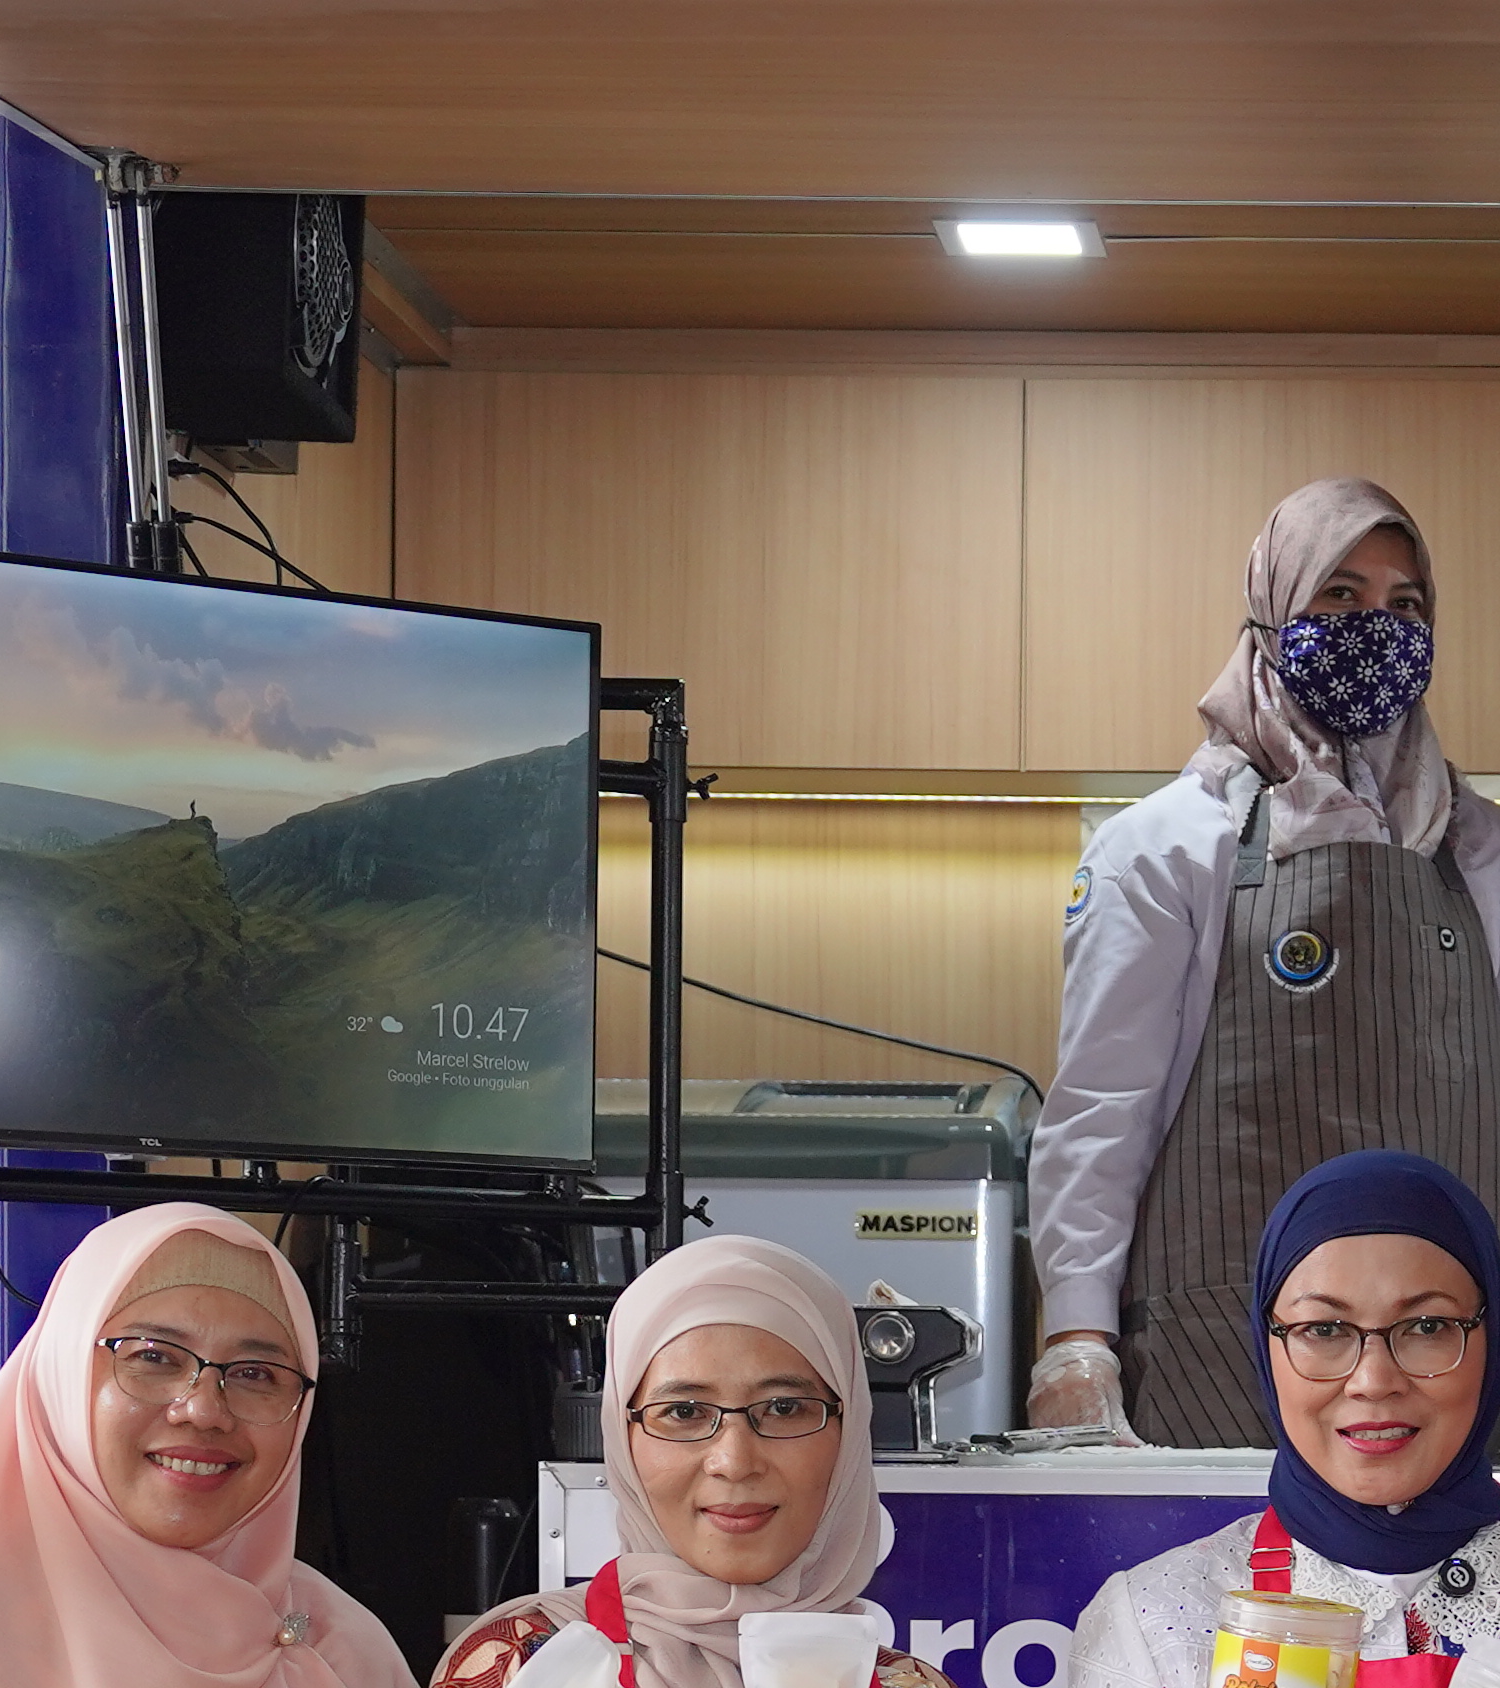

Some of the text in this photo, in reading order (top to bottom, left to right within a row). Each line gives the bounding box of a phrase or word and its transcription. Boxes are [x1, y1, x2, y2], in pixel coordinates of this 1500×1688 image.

[431, 1002, 530, 1043] 10.47
[417, 1051, 530, 1072] Marcel Strelow
[387, 1069, 530, 1091] Google Foto unggulan
[138, 1137, 163, 1147] TCL
[861, 1214, 973, 1233] MASPION
